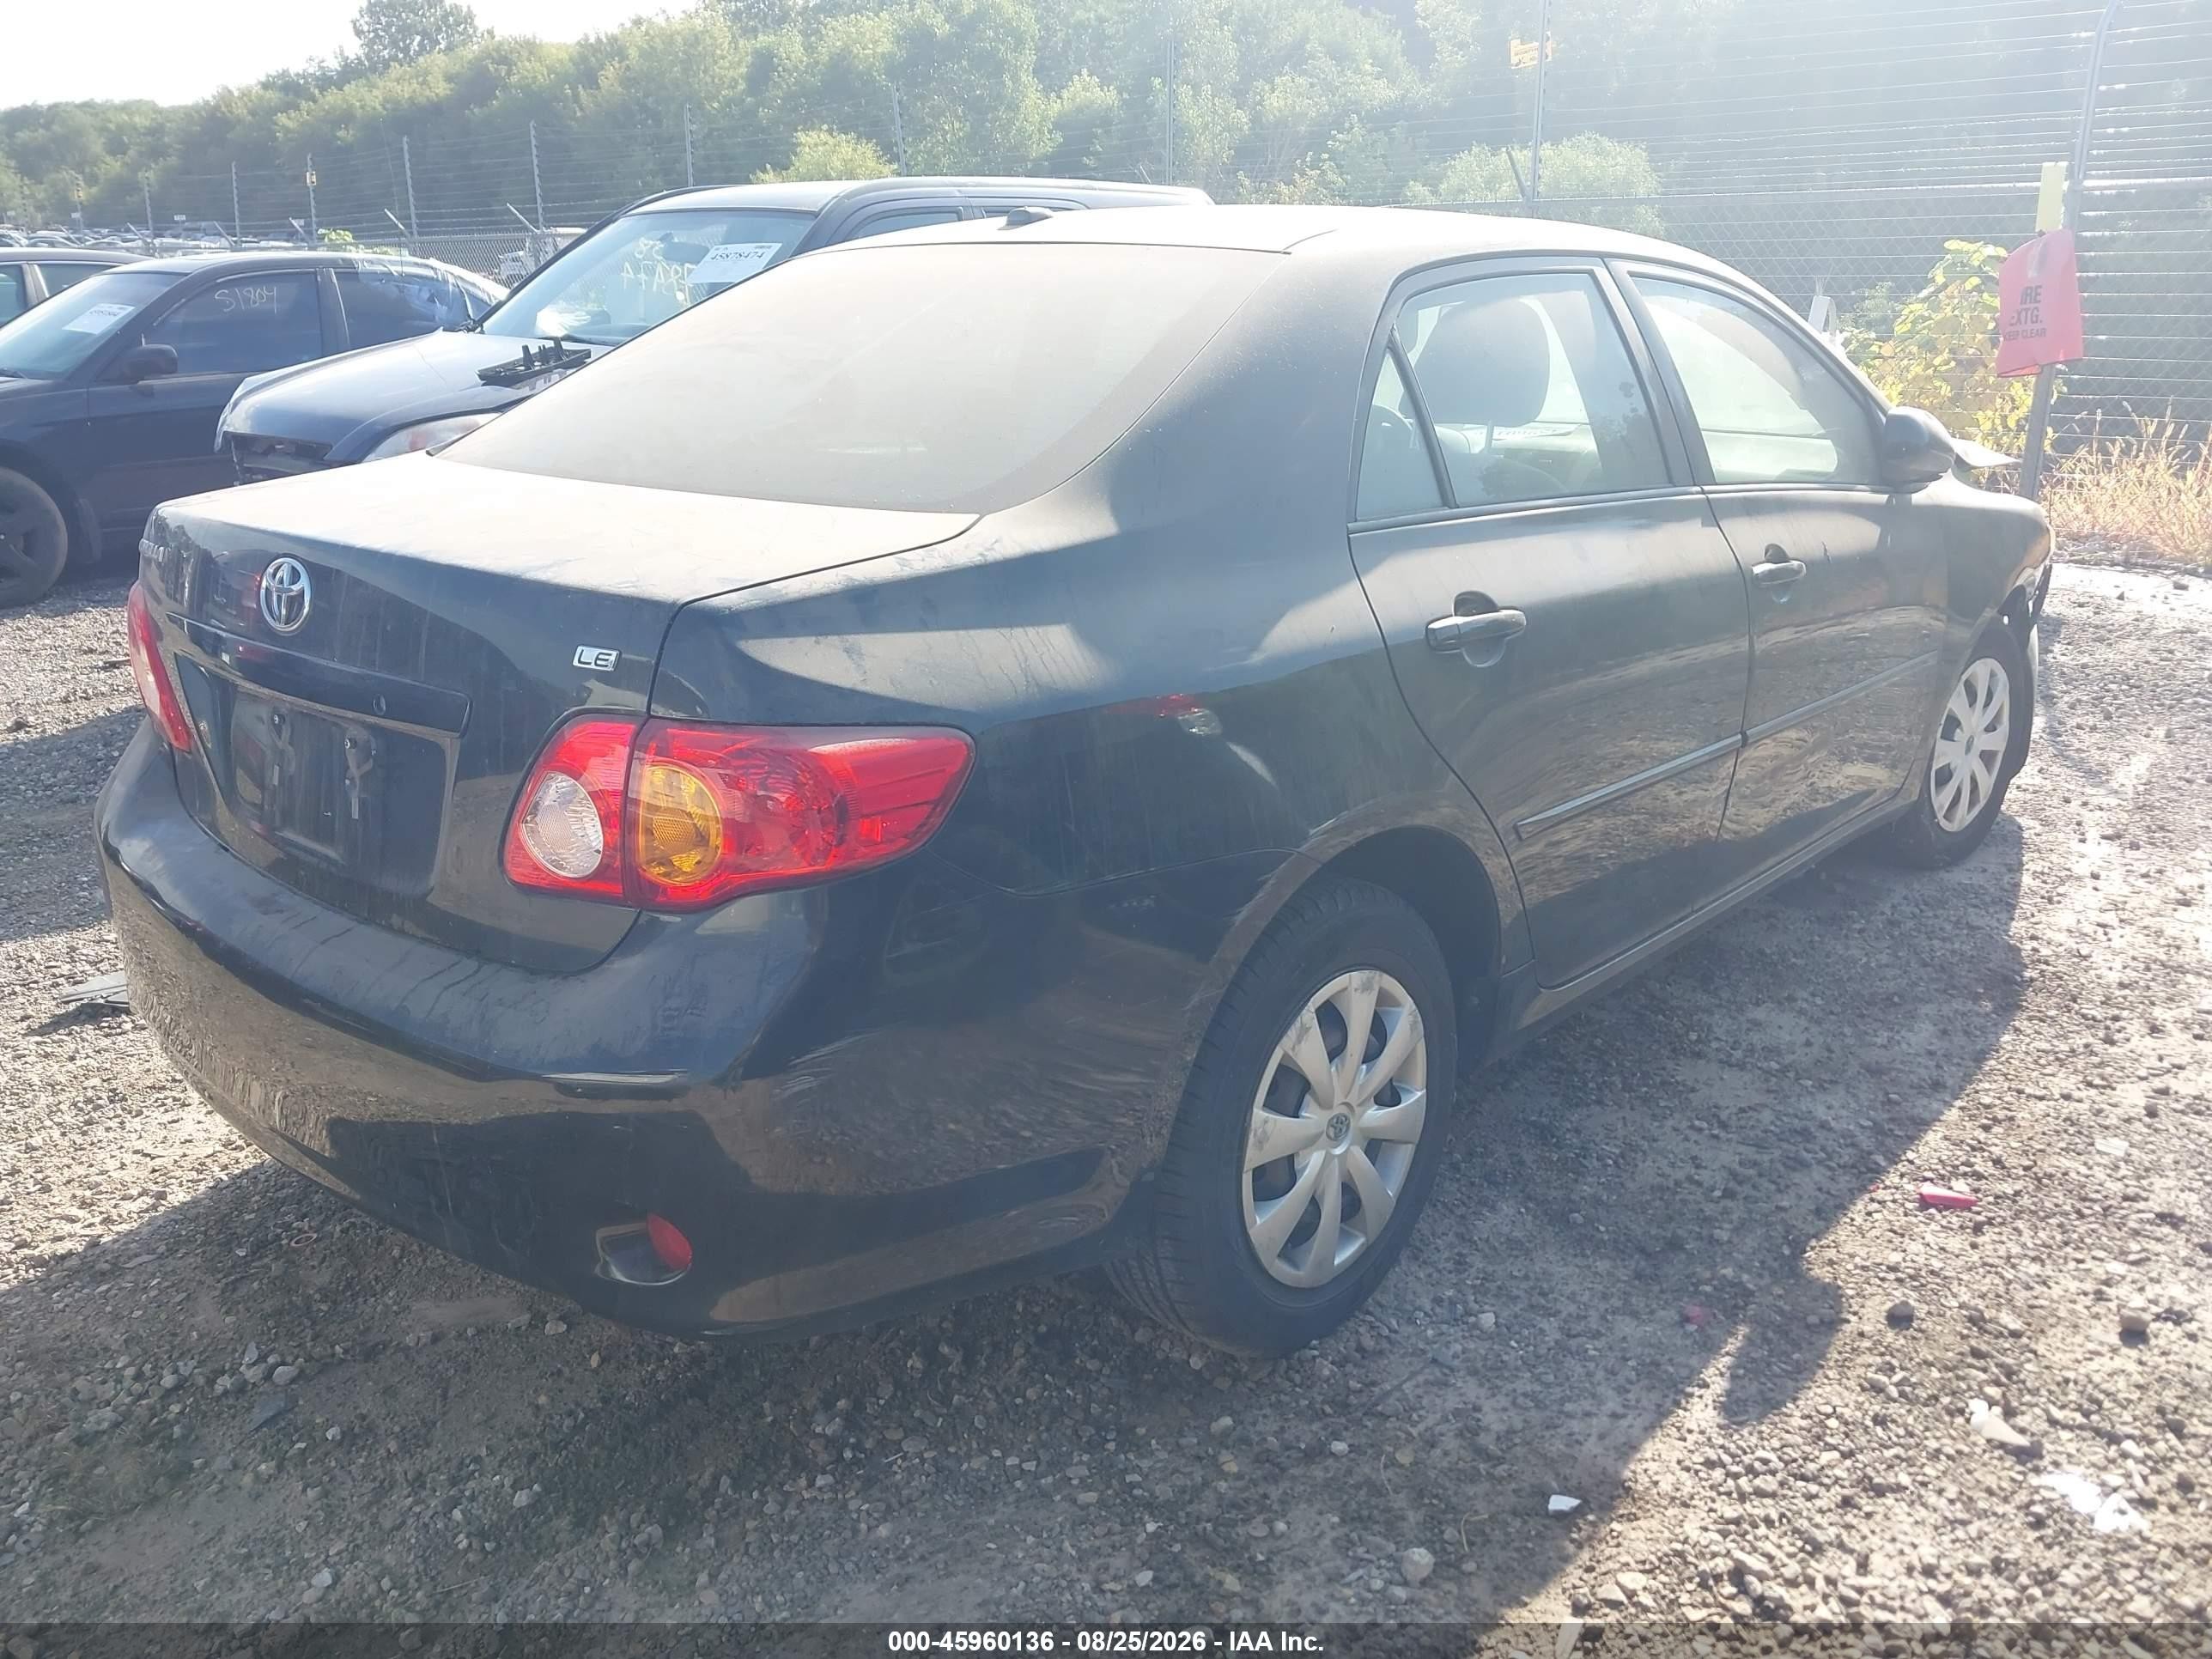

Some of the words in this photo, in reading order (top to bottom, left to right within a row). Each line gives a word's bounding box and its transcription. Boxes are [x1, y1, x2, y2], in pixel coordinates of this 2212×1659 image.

[2020, 285, 2042, 305] IRE
[2021, 327, 2046, 337] CLEAR
[577, 649, 611, 667] LE
